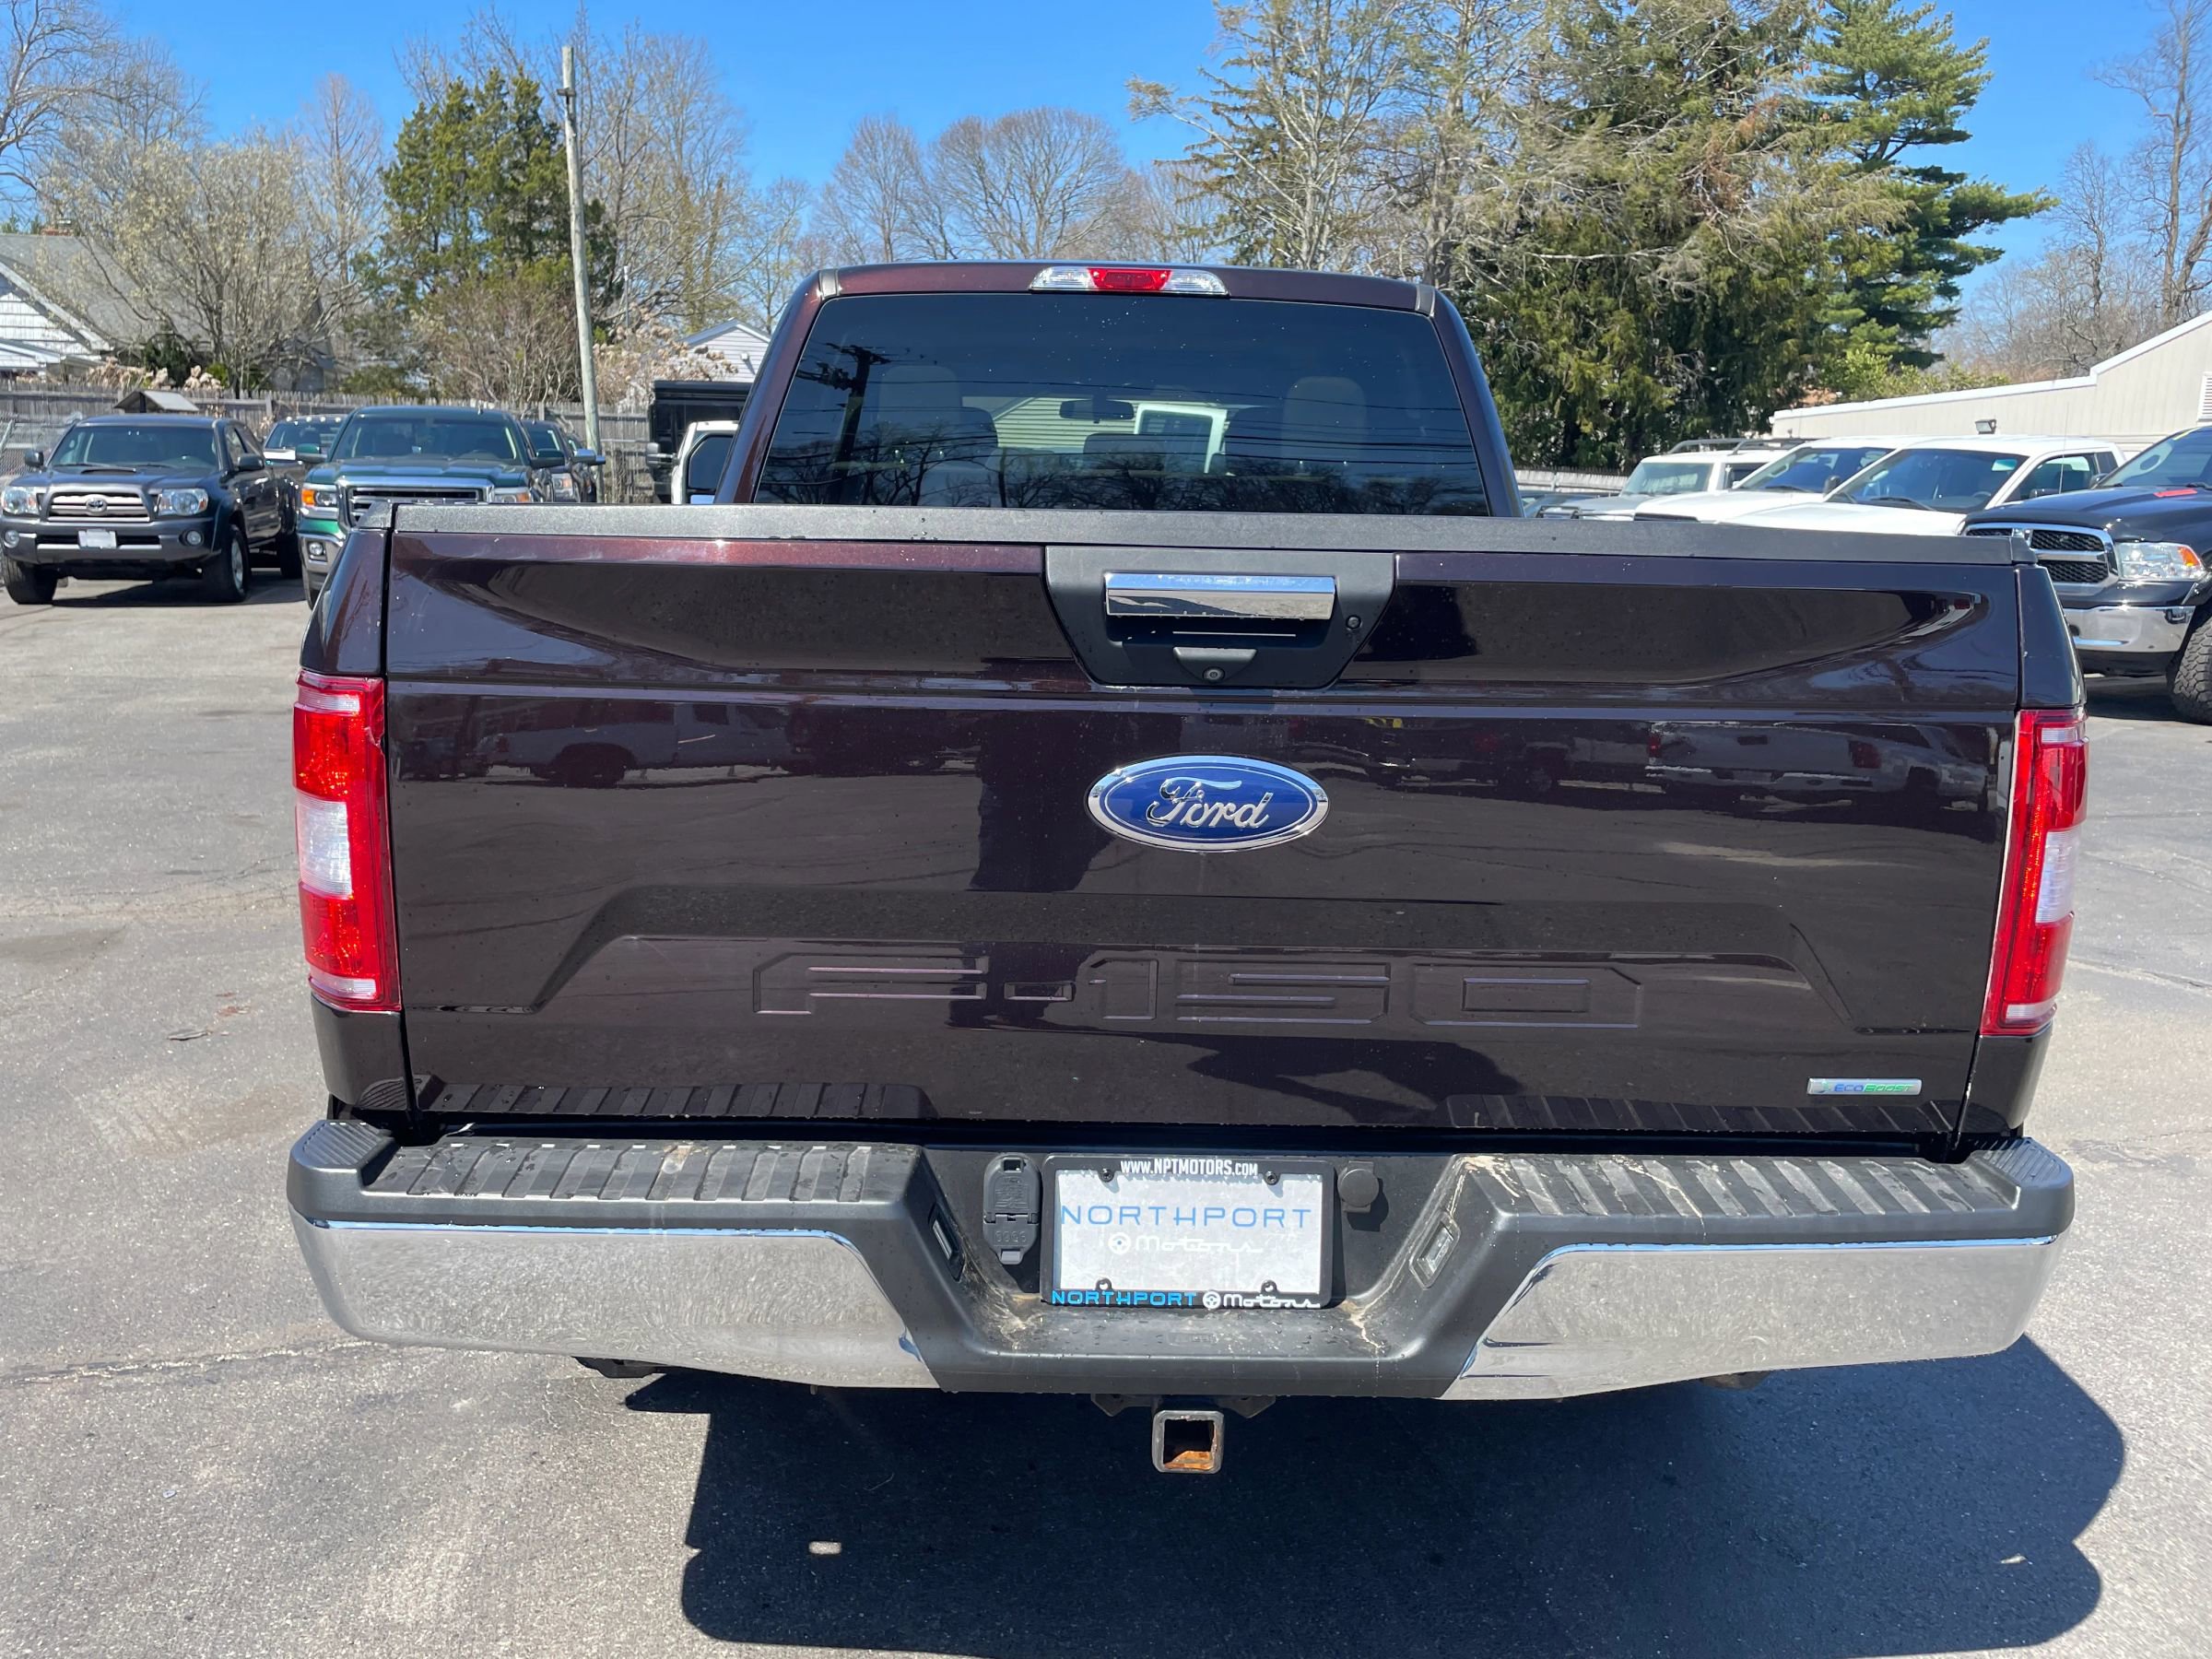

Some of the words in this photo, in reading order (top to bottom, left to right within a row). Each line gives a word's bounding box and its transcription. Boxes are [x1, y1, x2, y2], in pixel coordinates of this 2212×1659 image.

[1146, 776, 1274, 828] Ford
[752, 952, 1644, 1029] F-150
[1120, 1158, 1258, 1176] WWW.NPTMOTORS.COM
[1061, 1205, 1312, 1228] NORTHPORT
[1052, 1290, 1196, 1306] NORTHPORT
